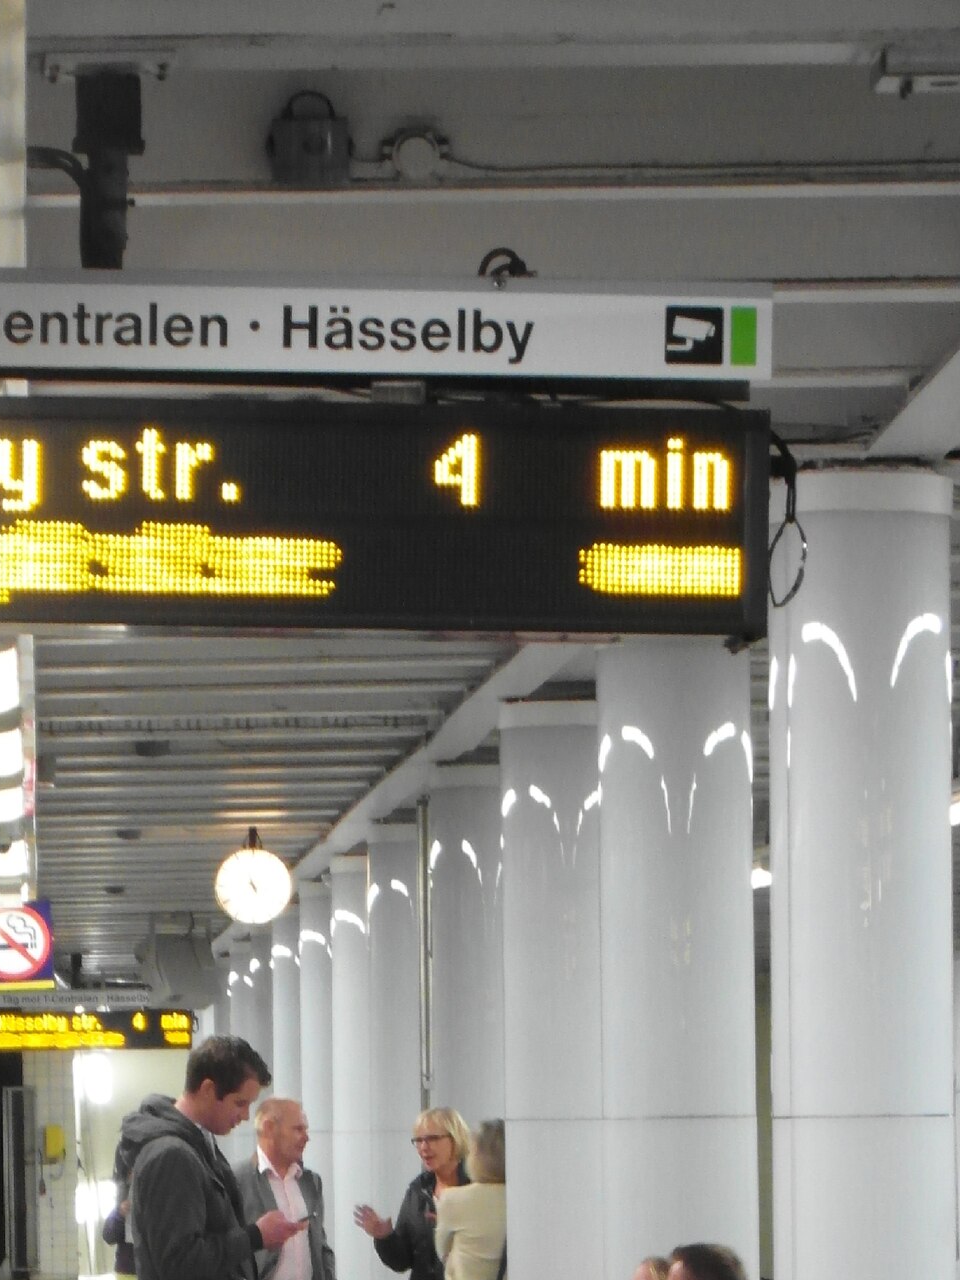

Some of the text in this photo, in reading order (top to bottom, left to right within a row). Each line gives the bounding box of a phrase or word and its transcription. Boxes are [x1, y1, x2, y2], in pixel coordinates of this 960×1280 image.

[282, 304, 534, 365] Hässelby
[80, 427, 241, 501] str.
[434, 433, 480, 507] 4
[598, 437, 732, 511] min
